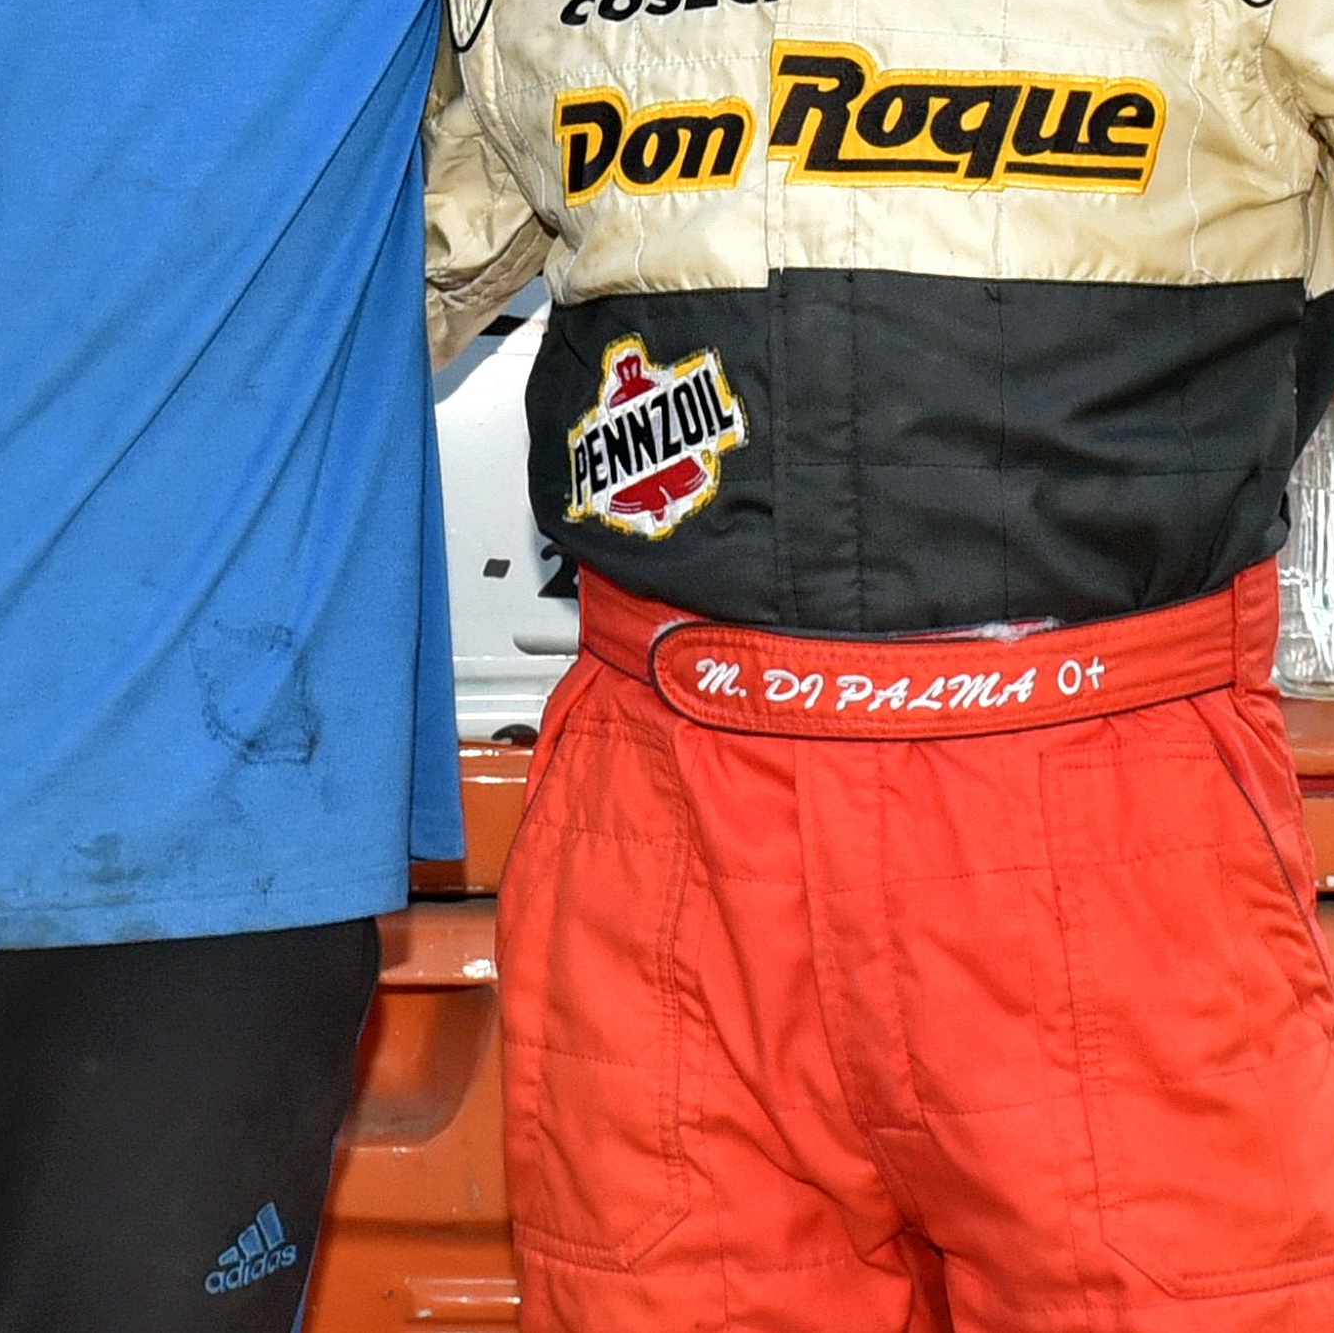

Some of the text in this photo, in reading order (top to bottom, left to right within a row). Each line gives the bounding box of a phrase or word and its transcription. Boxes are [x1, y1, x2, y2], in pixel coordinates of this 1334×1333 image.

[560, 54, 1157, 194] Don Roque
[575, 369, 734, 506] PENNZOIL
[695, 657, 747, 697] M.
[763, 668, 824, 709] DI
[836, 668, 1038, 712] PALMA
[205, 1244, 298, 1295] adidas
